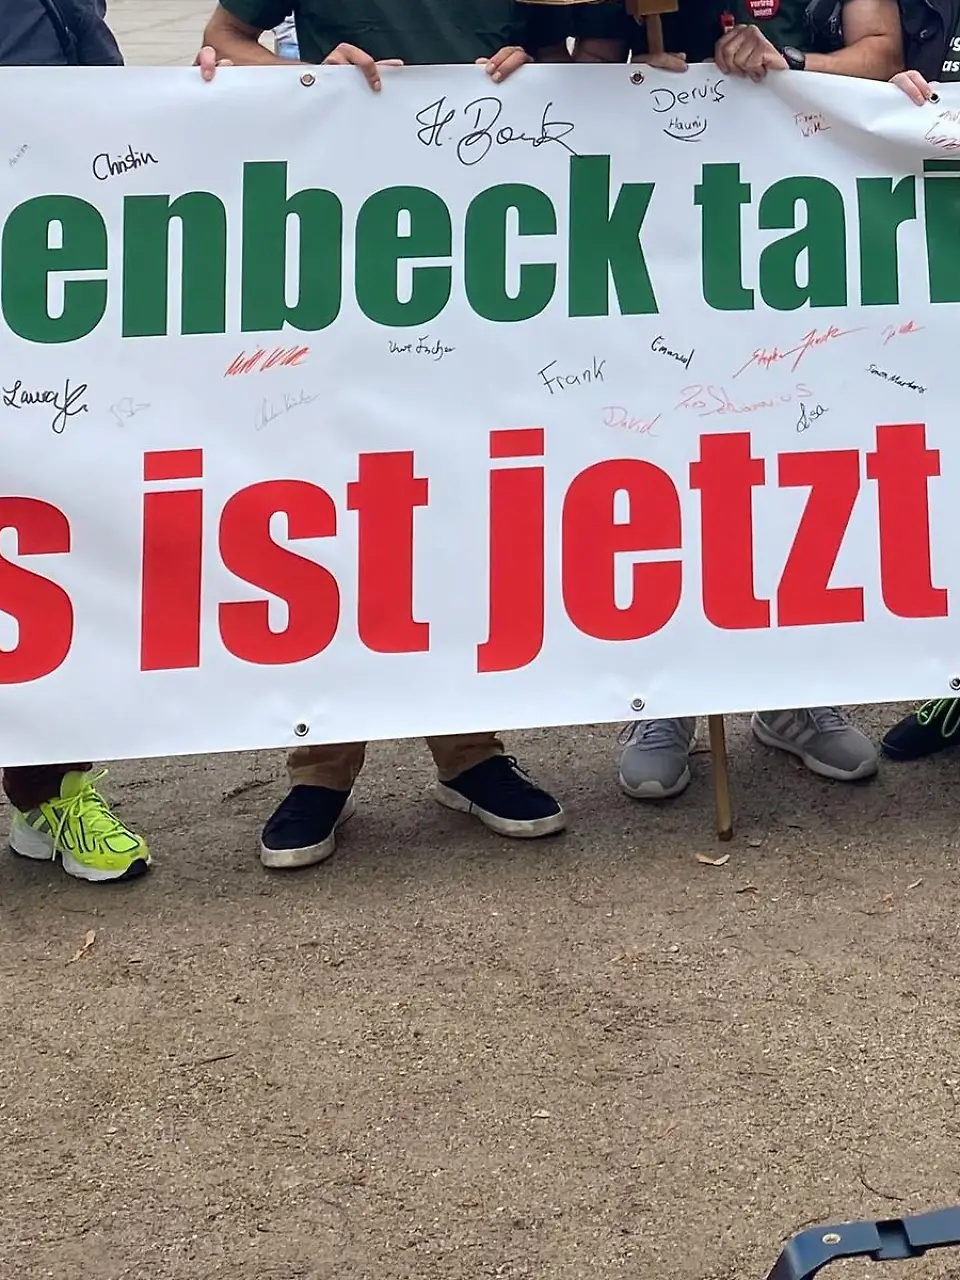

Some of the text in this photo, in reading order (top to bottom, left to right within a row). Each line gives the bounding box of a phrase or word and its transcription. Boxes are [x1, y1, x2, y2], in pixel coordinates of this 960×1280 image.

[0, 155, 660, 344] enbeck
[537, 356, 606, 394] Frank
[140, 448, 429, 671] ist
[477, 423, 948, 674] jetzt
